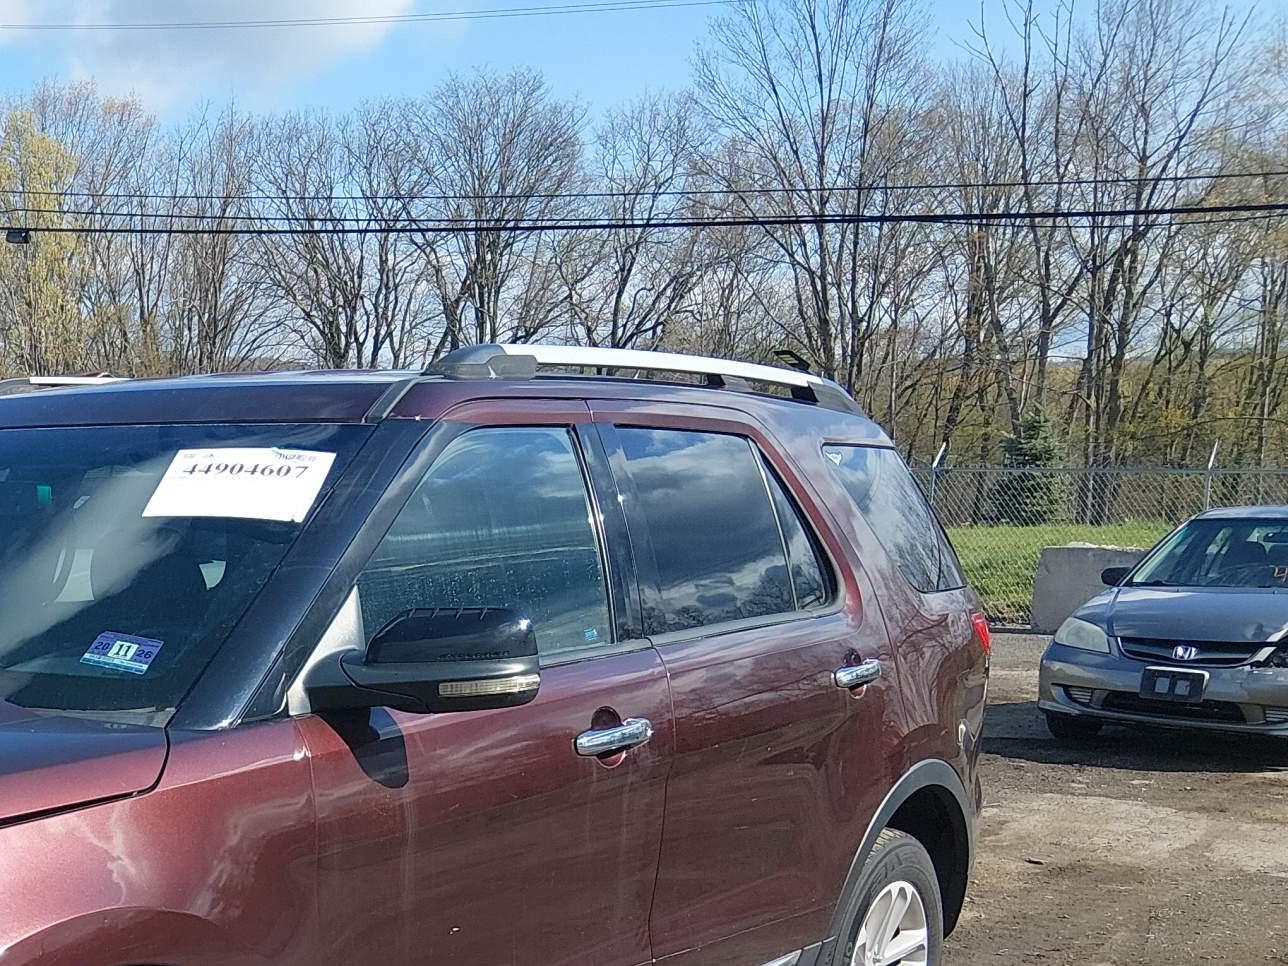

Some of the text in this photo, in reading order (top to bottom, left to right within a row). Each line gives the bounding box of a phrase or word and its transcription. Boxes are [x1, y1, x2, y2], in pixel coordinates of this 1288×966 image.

[182, 463, 310, 479] 44904607
[94, 641, 153, 659] 20 11 26
